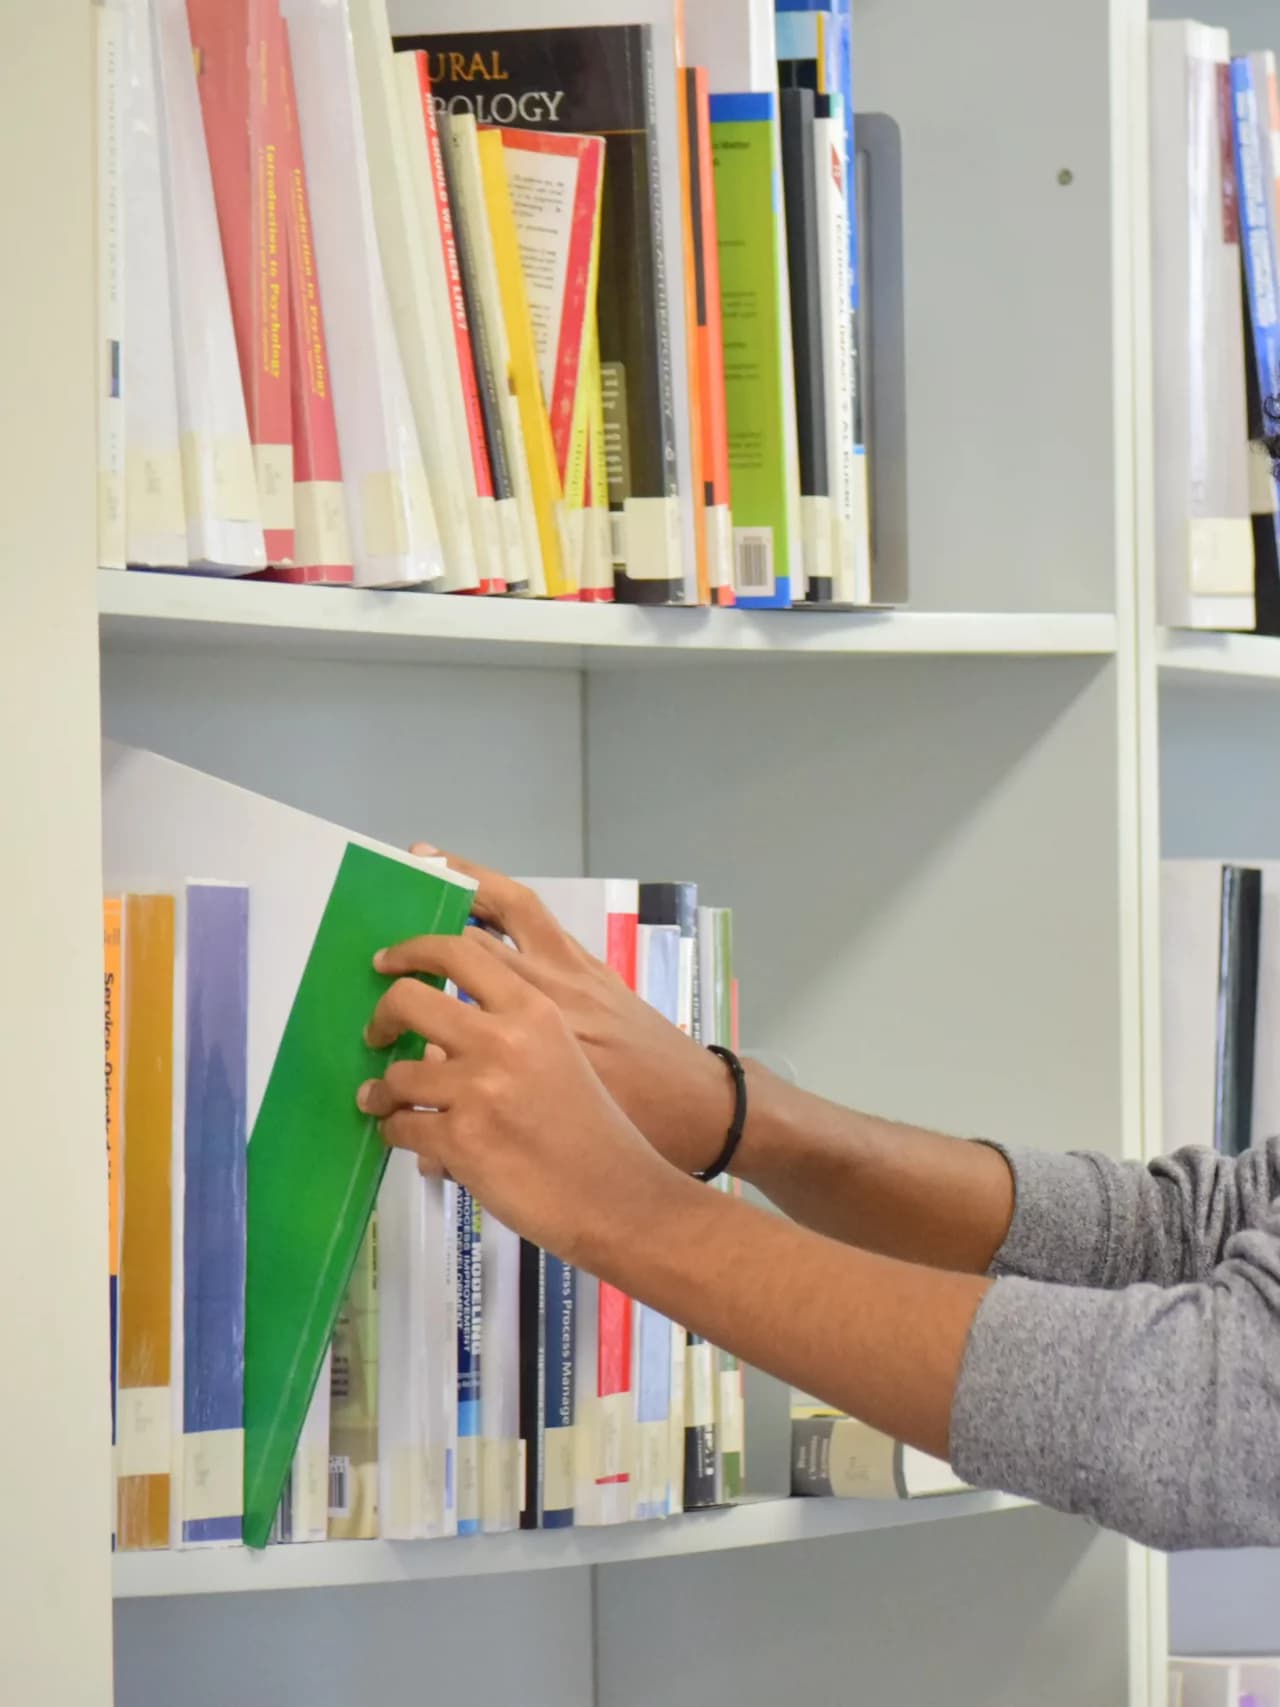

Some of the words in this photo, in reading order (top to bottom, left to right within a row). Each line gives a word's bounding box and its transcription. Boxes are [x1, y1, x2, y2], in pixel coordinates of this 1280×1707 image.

[428, 50, 509, 82] URAL
[425, 92, 438, 131] HOW
[431, 136, 448, 203] SHOULD
[265, 144, 279, 255] Introduction
[292, 168, 314, 276] Introduction
[440, 207, 453, 233] WE
[269, 260, 279, 277] to
[444, 239, 461, 281] THEN
[306, 282, 316, 299] to
[451, 285, 468, 331] LIVE?
[268, 283, 281, 379] Psychology
[309, 305, 327, 401] Psychology
[463, 1255, 471, 1352] IMPROVEMENT
[561, 1299, 573, 1358] Process
[558, 1361, 573, 1425] Manage
